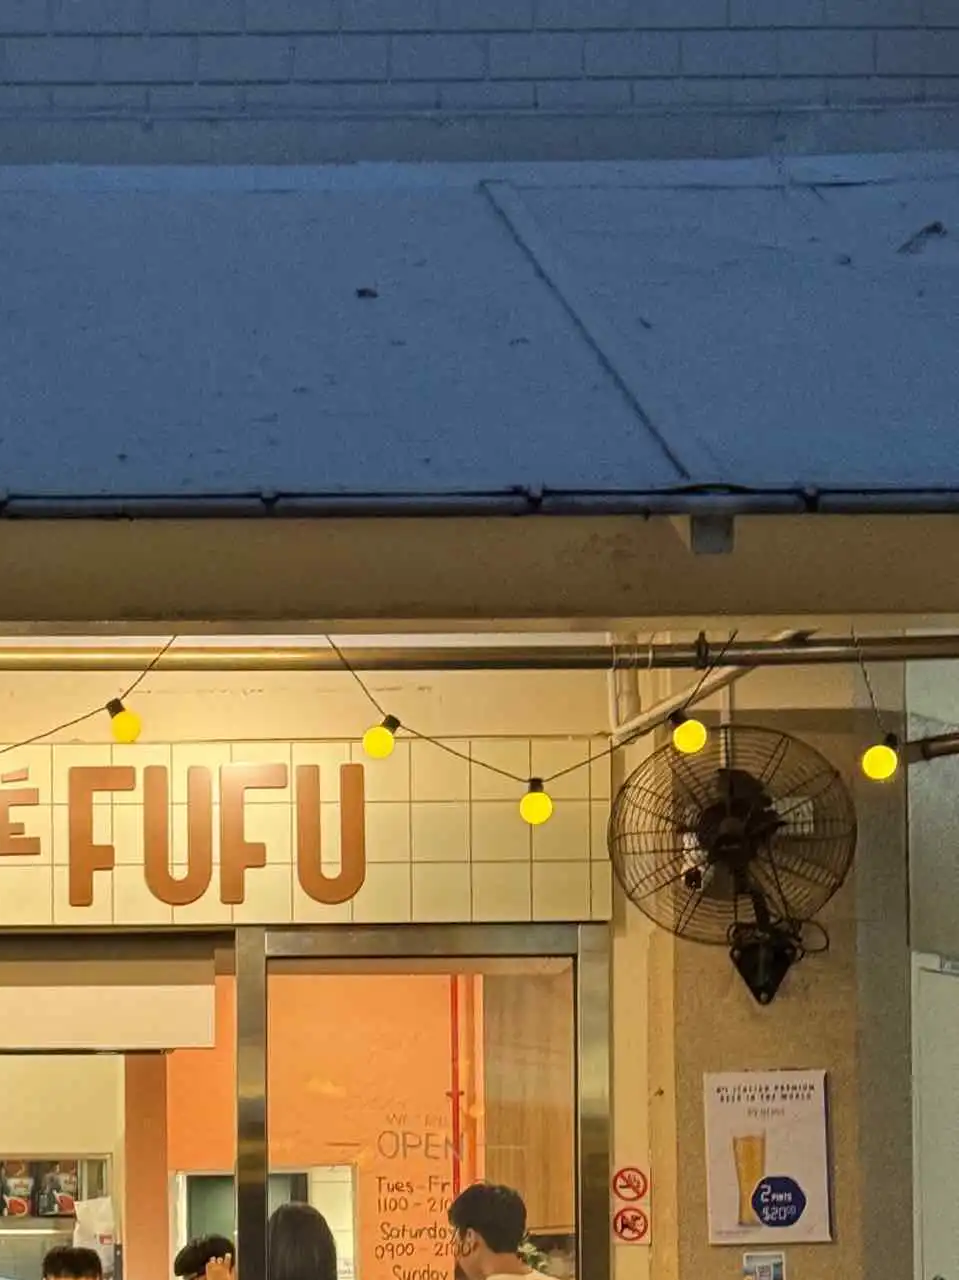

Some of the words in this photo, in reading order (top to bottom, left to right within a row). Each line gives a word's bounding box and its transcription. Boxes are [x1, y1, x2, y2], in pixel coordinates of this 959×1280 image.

[67, 763, 366, 907] FUFU
[377, 1130, 464, 1162] OPEN
[376, 1176, 414, 1194] Tues
[428, 1175, 452, 1193] Fr
[760, 1184, 772, 1202] 2
[377, 1196, 409, 1213] 1100
[426, 1196, 451, 1213] 21
[380, 1220, 458, 1244] Saturday
[375, 1242, 415, 1260] 0900
